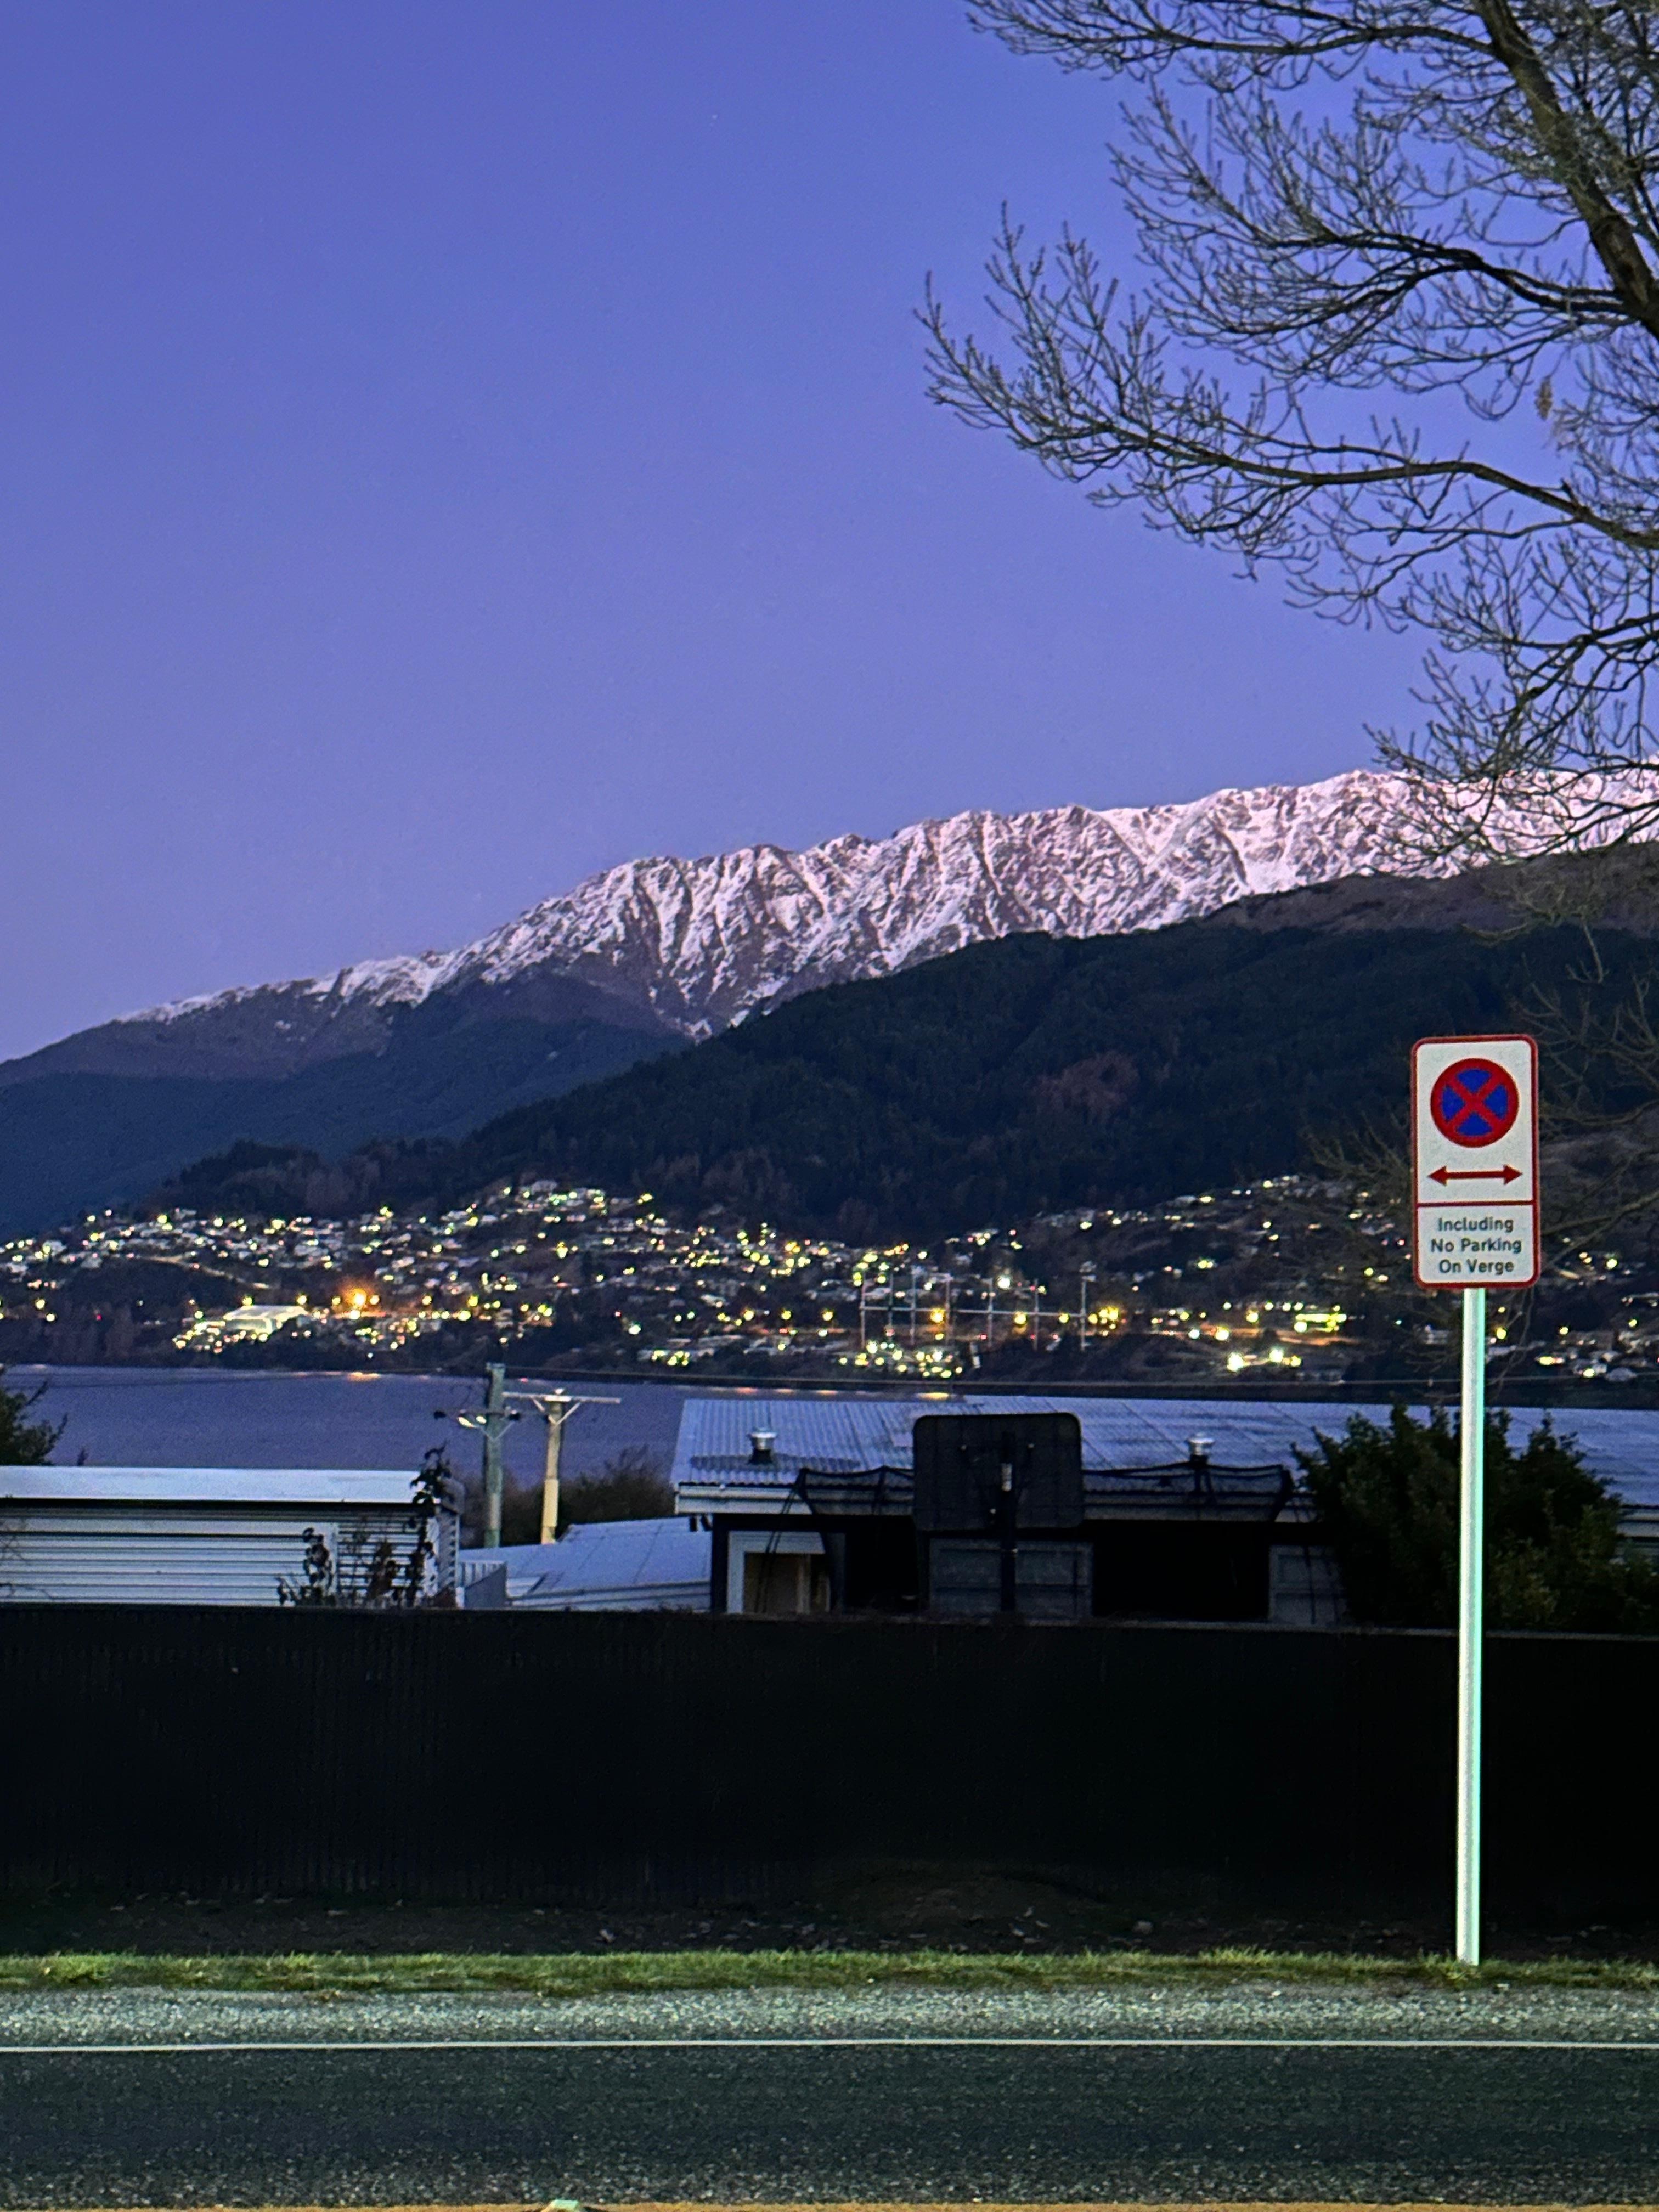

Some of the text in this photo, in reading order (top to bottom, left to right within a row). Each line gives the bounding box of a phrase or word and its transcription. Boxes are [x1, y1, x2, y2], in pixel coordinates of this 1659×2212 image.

[1438, 1216, 1514, 1233] Including
[1430, 1237, 1522, 1254] No Parking
[1439, 1259, 1514, 1275] On Verge
